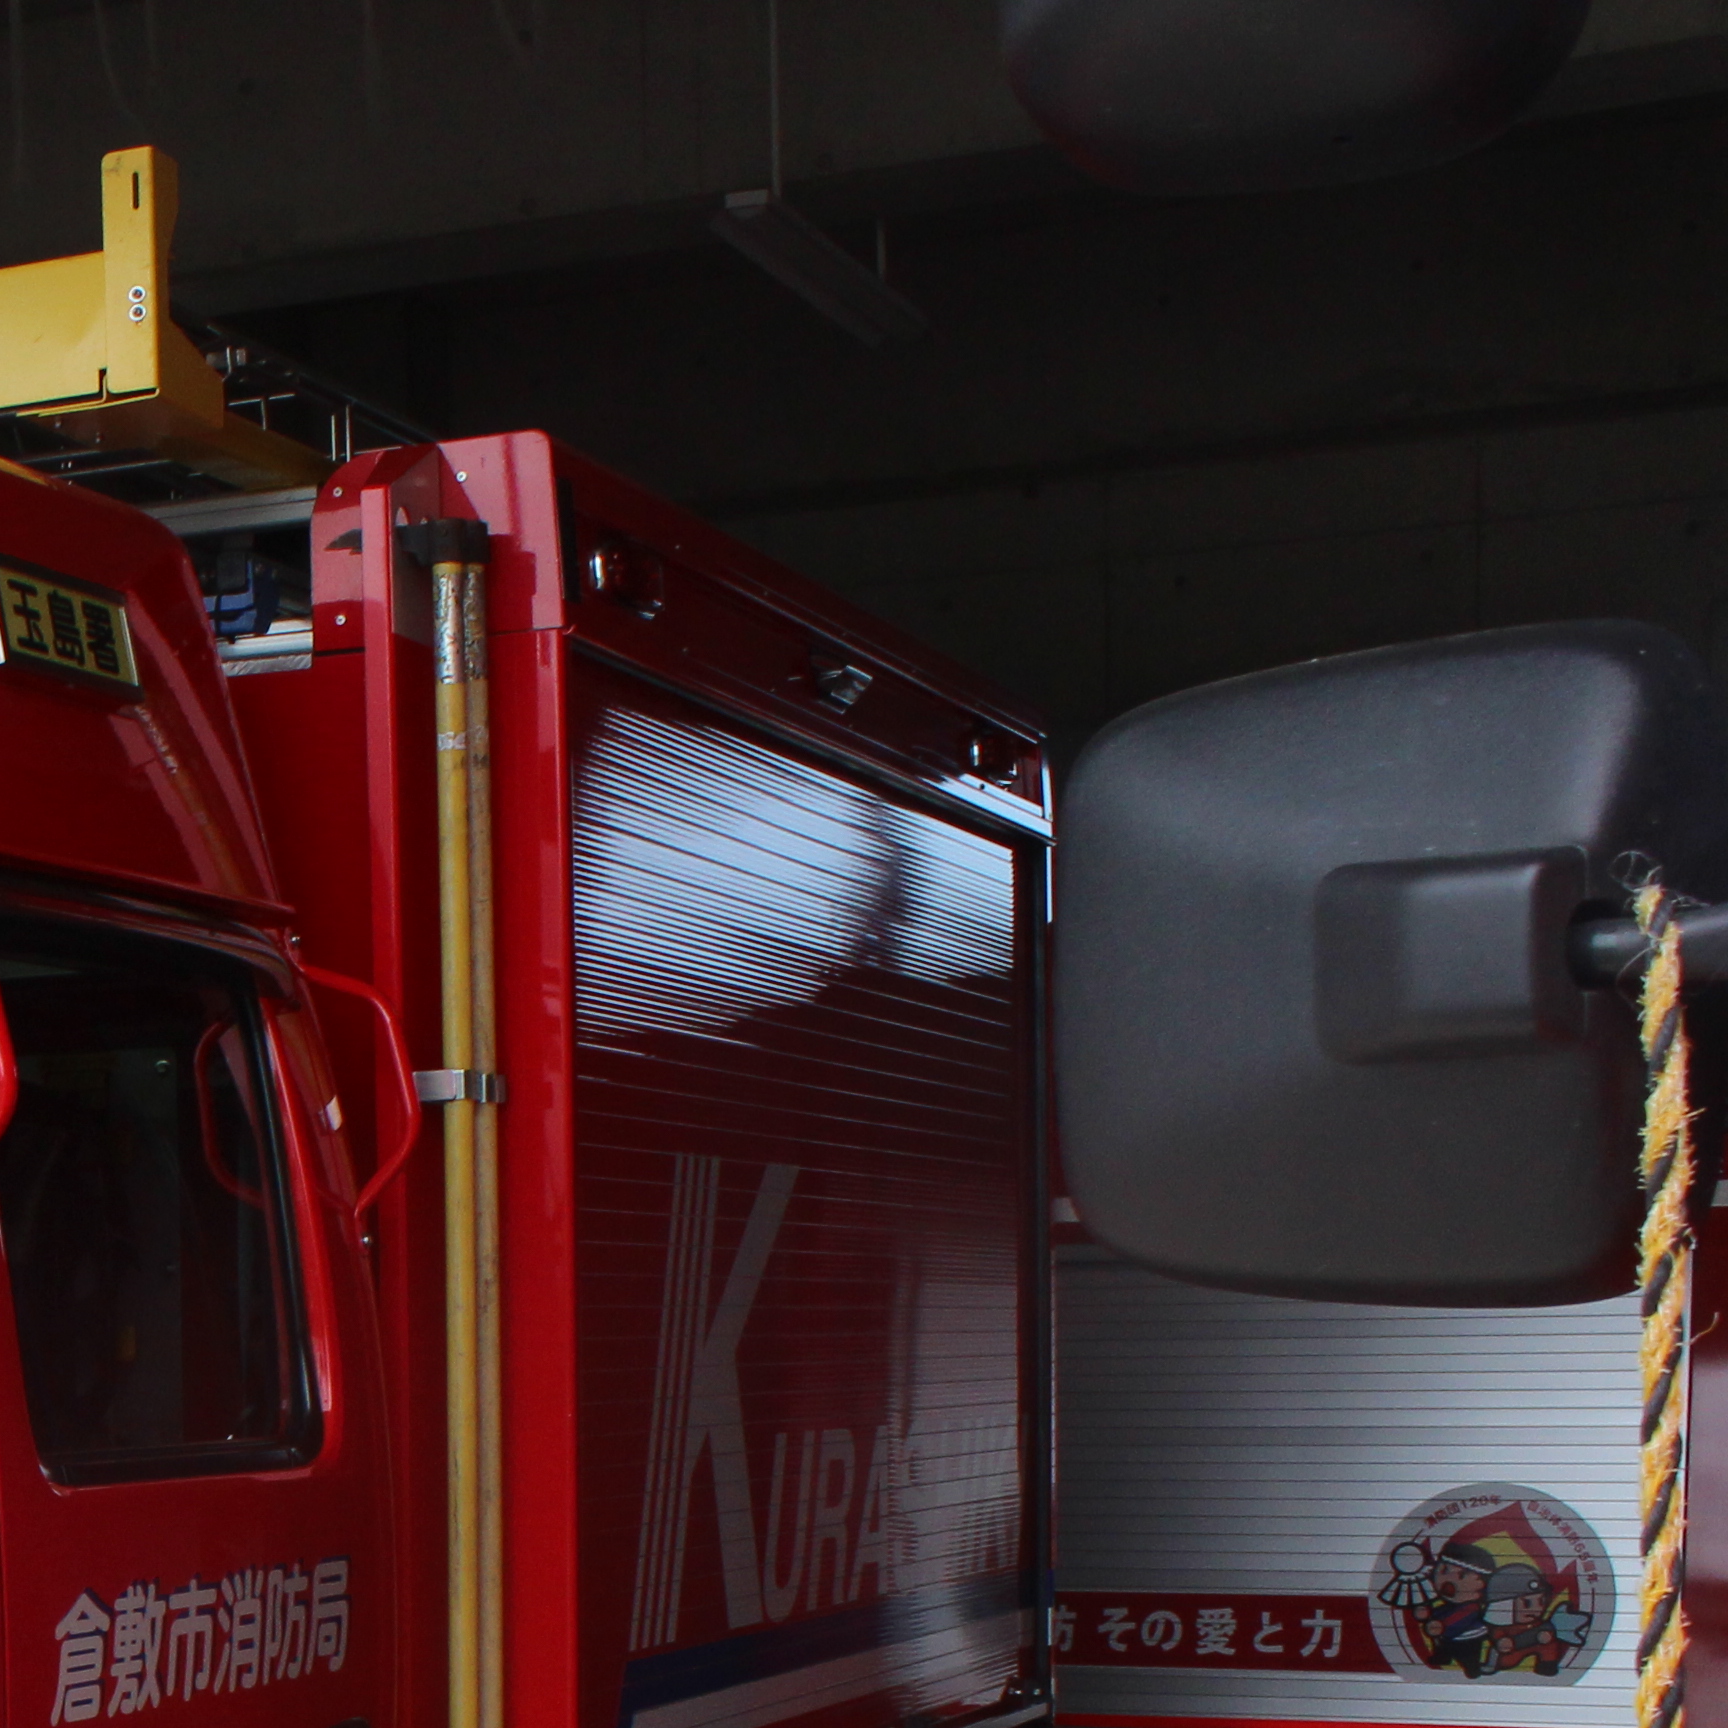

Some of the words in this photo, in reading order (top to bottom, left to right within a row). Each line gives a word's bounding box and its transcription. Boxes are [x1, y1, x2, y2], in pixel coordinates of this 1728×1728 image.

[50, 1556, 351, 1727] 倉敷市消防局
[1097, 1607, 1342, 1658] その愛と力
